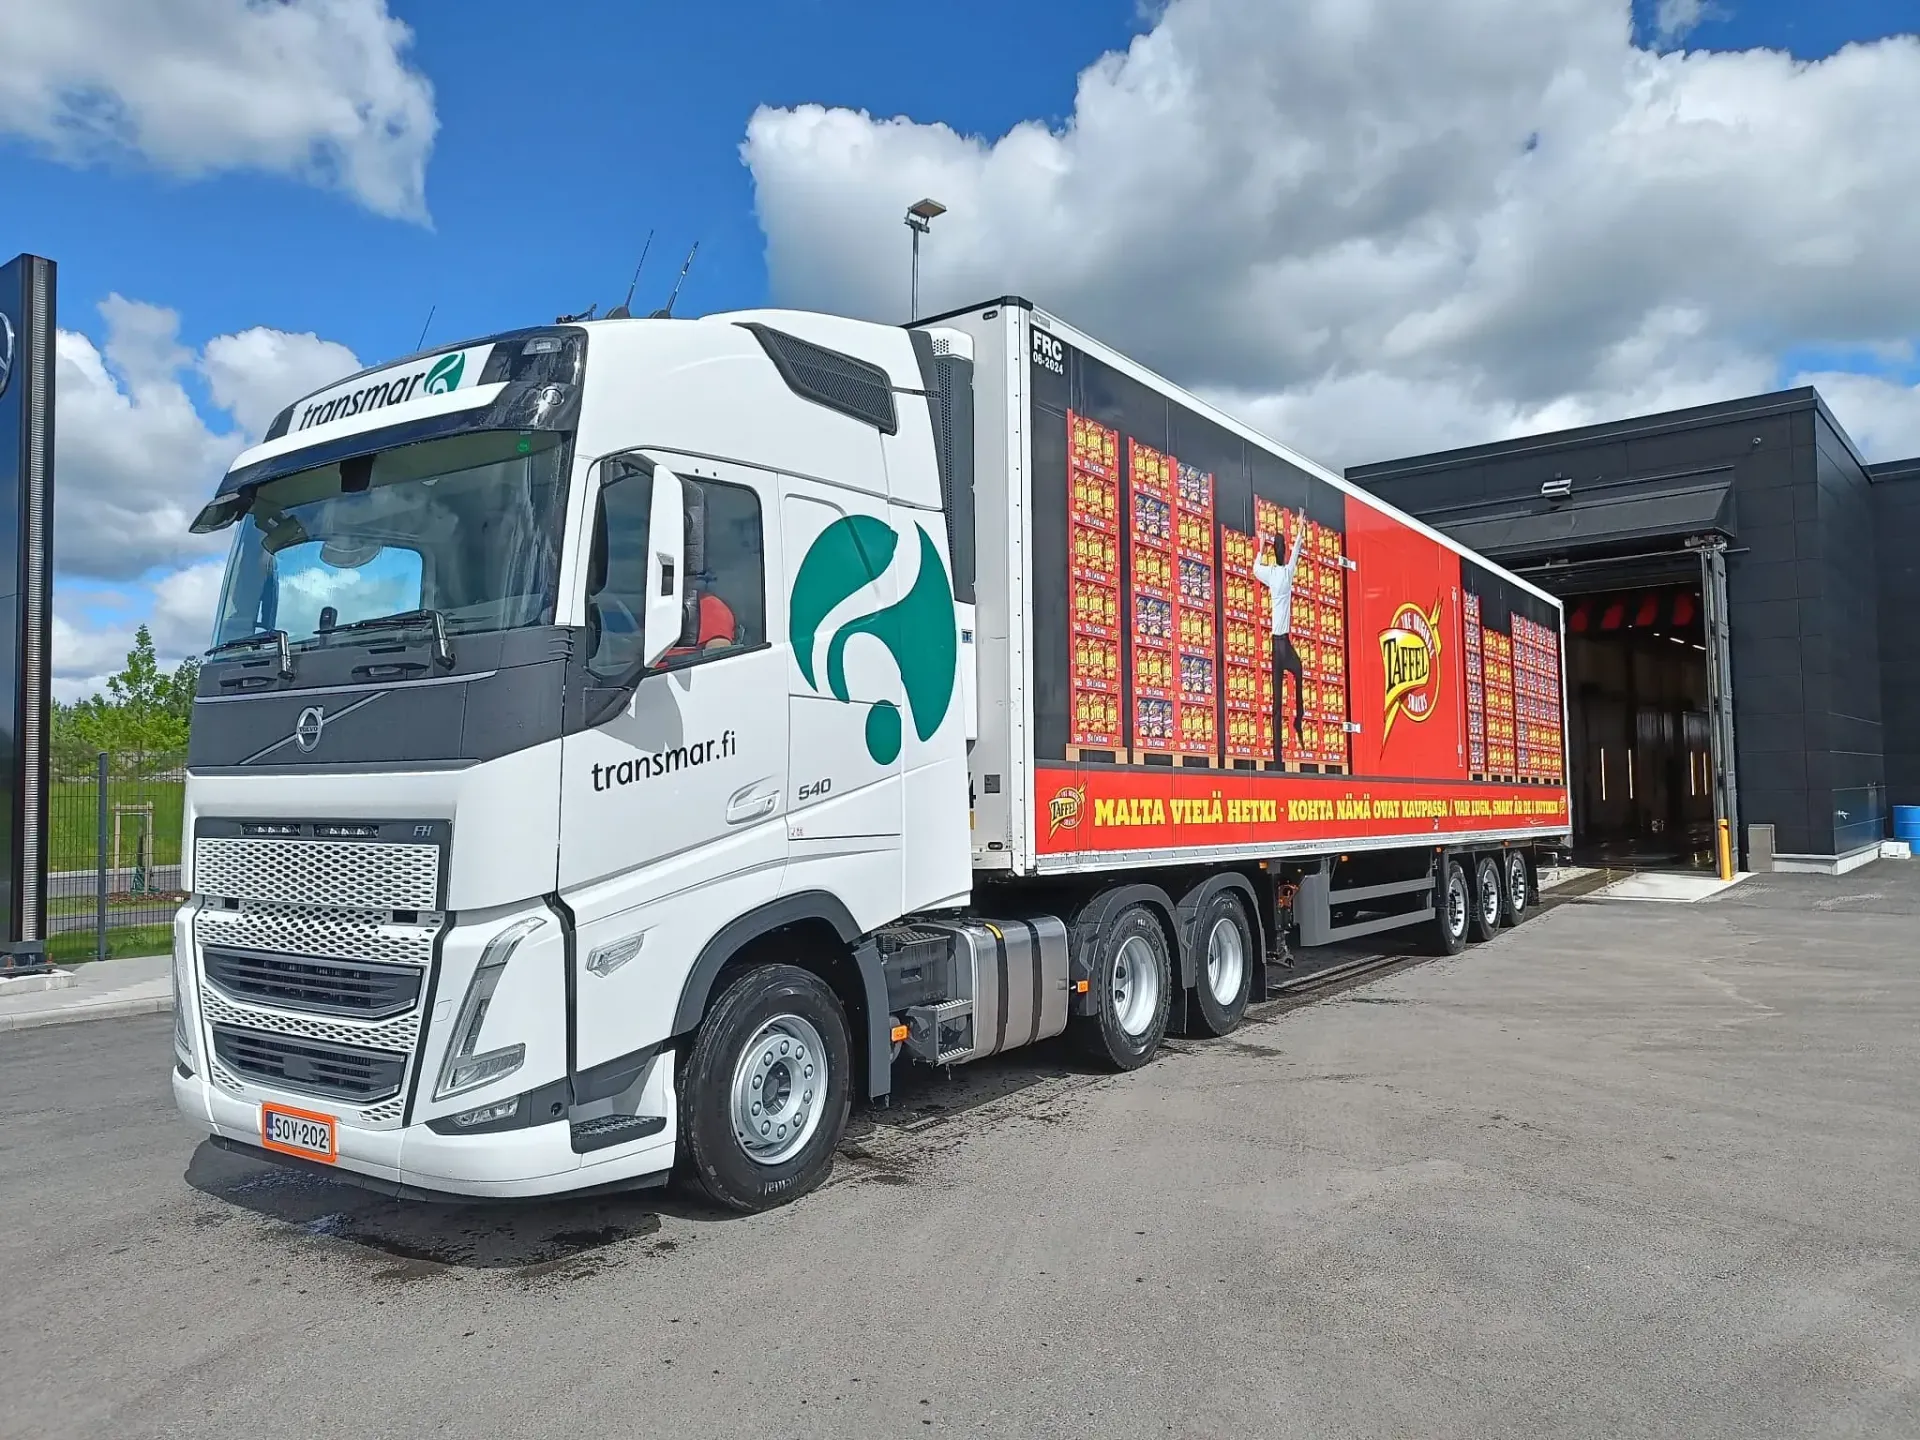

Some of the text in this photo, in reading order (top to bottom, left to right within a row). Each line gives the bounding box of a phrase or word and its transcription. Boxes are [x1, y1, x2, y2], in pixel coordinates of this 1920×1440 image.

[1033, 329, 1062, 361] FRC
[299, 372, 426, 431] transmar
[1383, 637, 1428, 694] TAFFEL
[591, 730, 736, 792] transmar.fi
[798, 778, 831, 801] 540
[1094, 799, 1166, 826] MALTA
[1169, 790, 1223, 824] VIELÄ
[1227, 799, 1276, 822] HETKI
[1288, 799, 1333, 821] KOHTA
[1336, 793, 1371, 821] NÄMÄ
[1373, 800, 1400, 818] OVAT
[1401, 800, 1447, 817] KAUPASSA
[1454, 800, 1470, 816] VAR
[412, 825, 434, 837] FH
[275, 1117, 327, 1149] SOV-202
